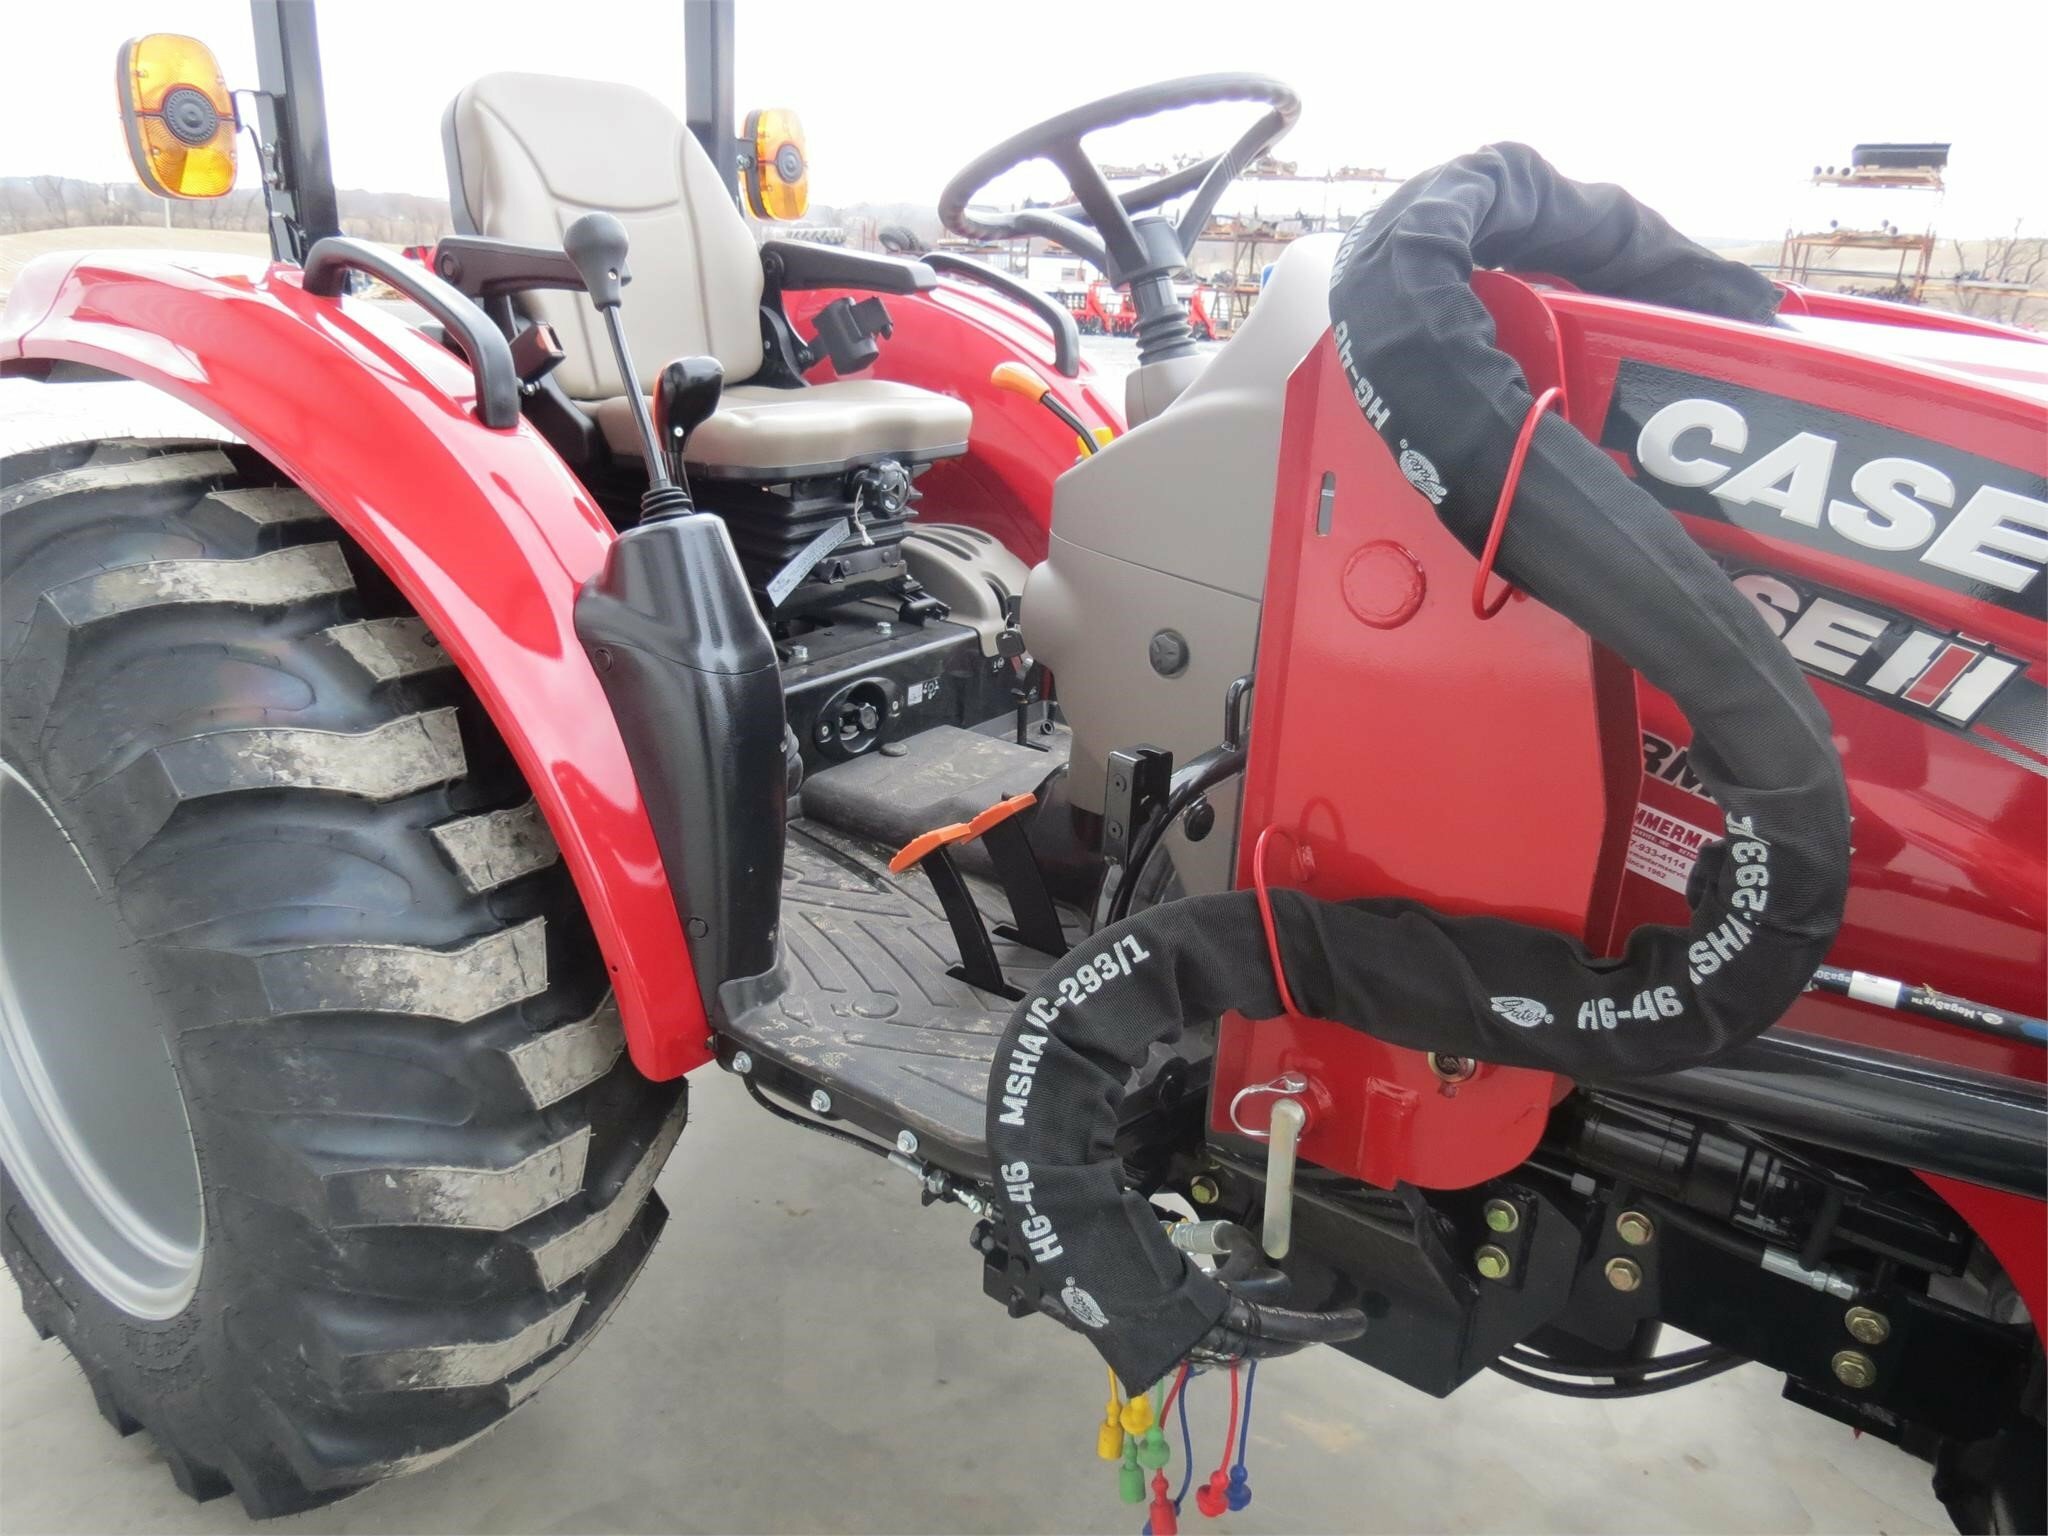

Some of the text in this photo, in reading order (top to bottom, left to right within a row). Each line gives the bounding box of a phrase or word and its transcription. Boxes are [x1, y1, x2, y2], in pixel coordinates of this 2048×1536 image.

[1334, 320, 1391, 431] HG-46
[1637, 398, 2048, 593] CASE
[1578, 986, 1684, 1030] HG-46
[999, 1034, 1048, 1125] MSHA
[1001, 1161, 1064, 1263] HG-46
